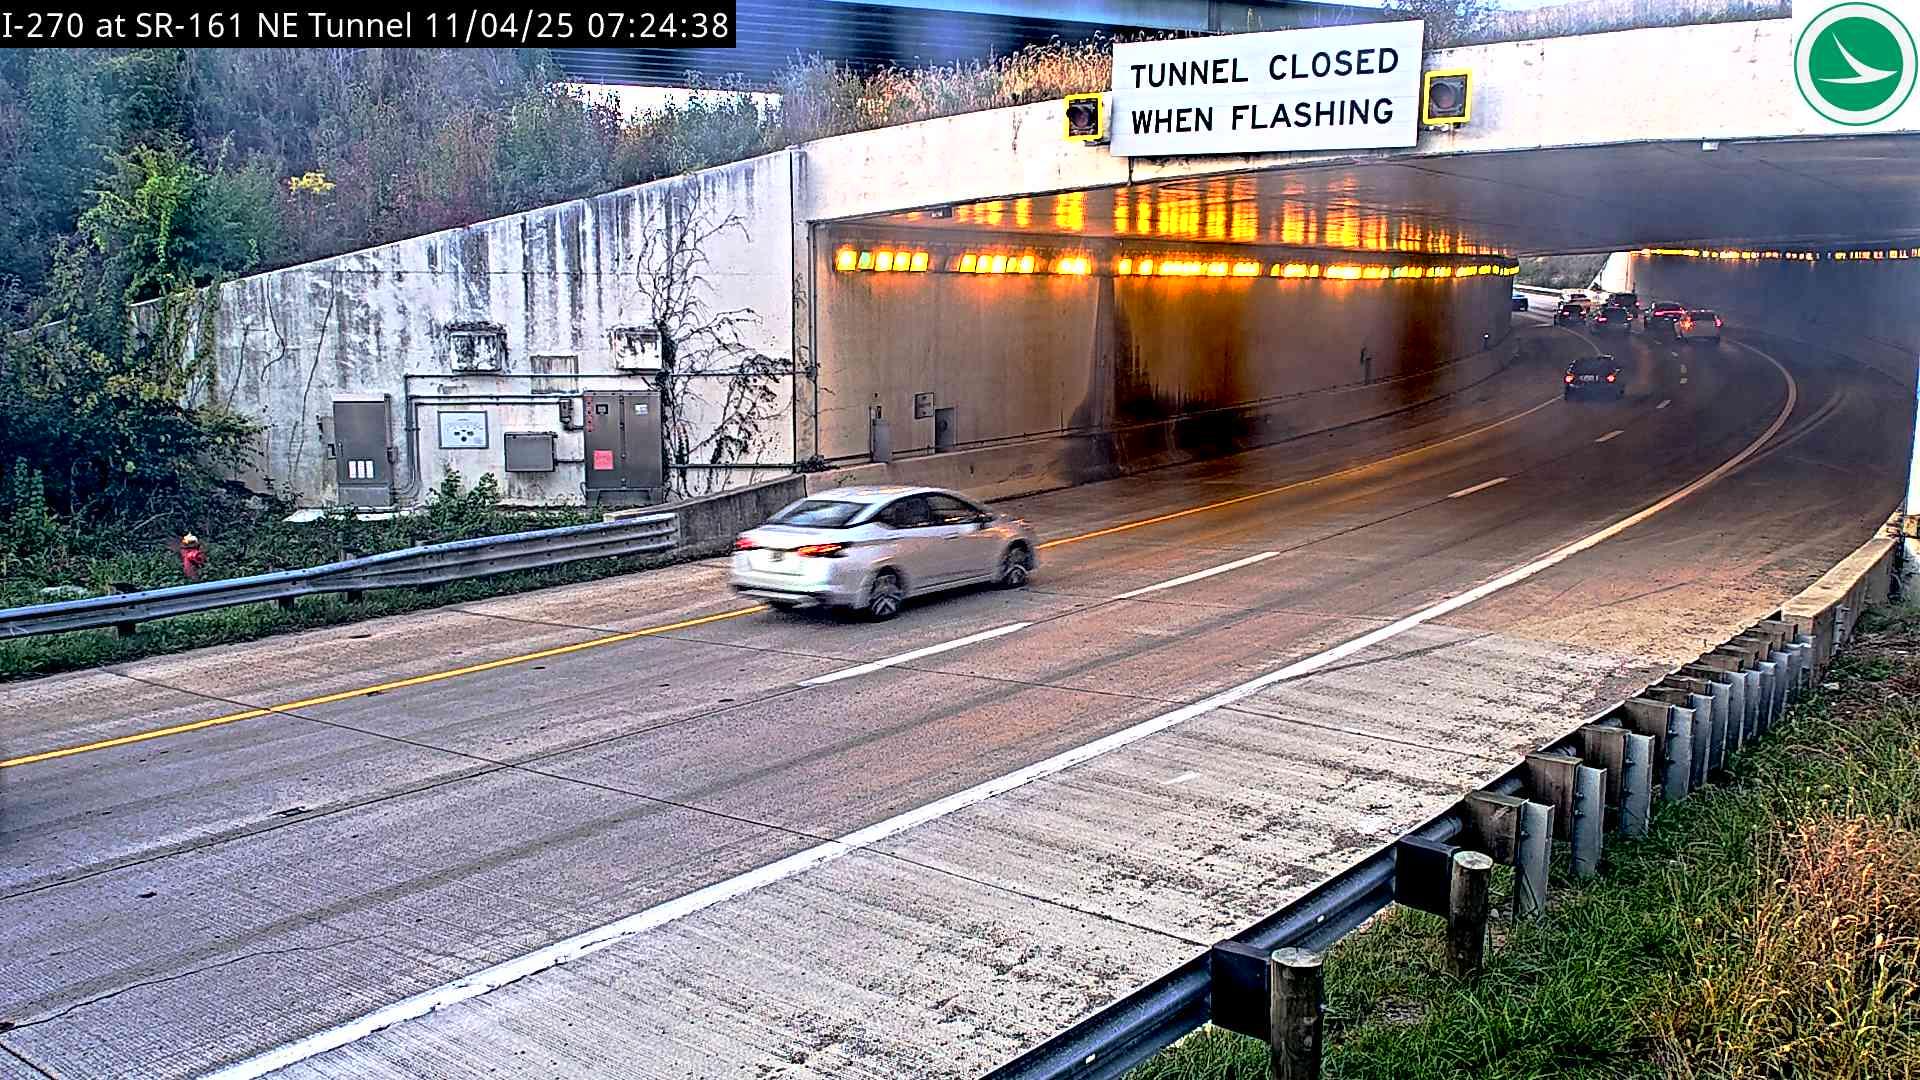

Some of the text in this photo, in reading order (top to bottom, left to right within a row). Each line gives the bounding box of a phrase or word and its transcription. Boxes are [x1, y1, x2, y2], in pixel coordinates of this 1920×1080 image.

[1130, 47, 1399, 88] TUNNEL CLOSED
[1131, 97, 1394, 135] WHEN FLASHING
